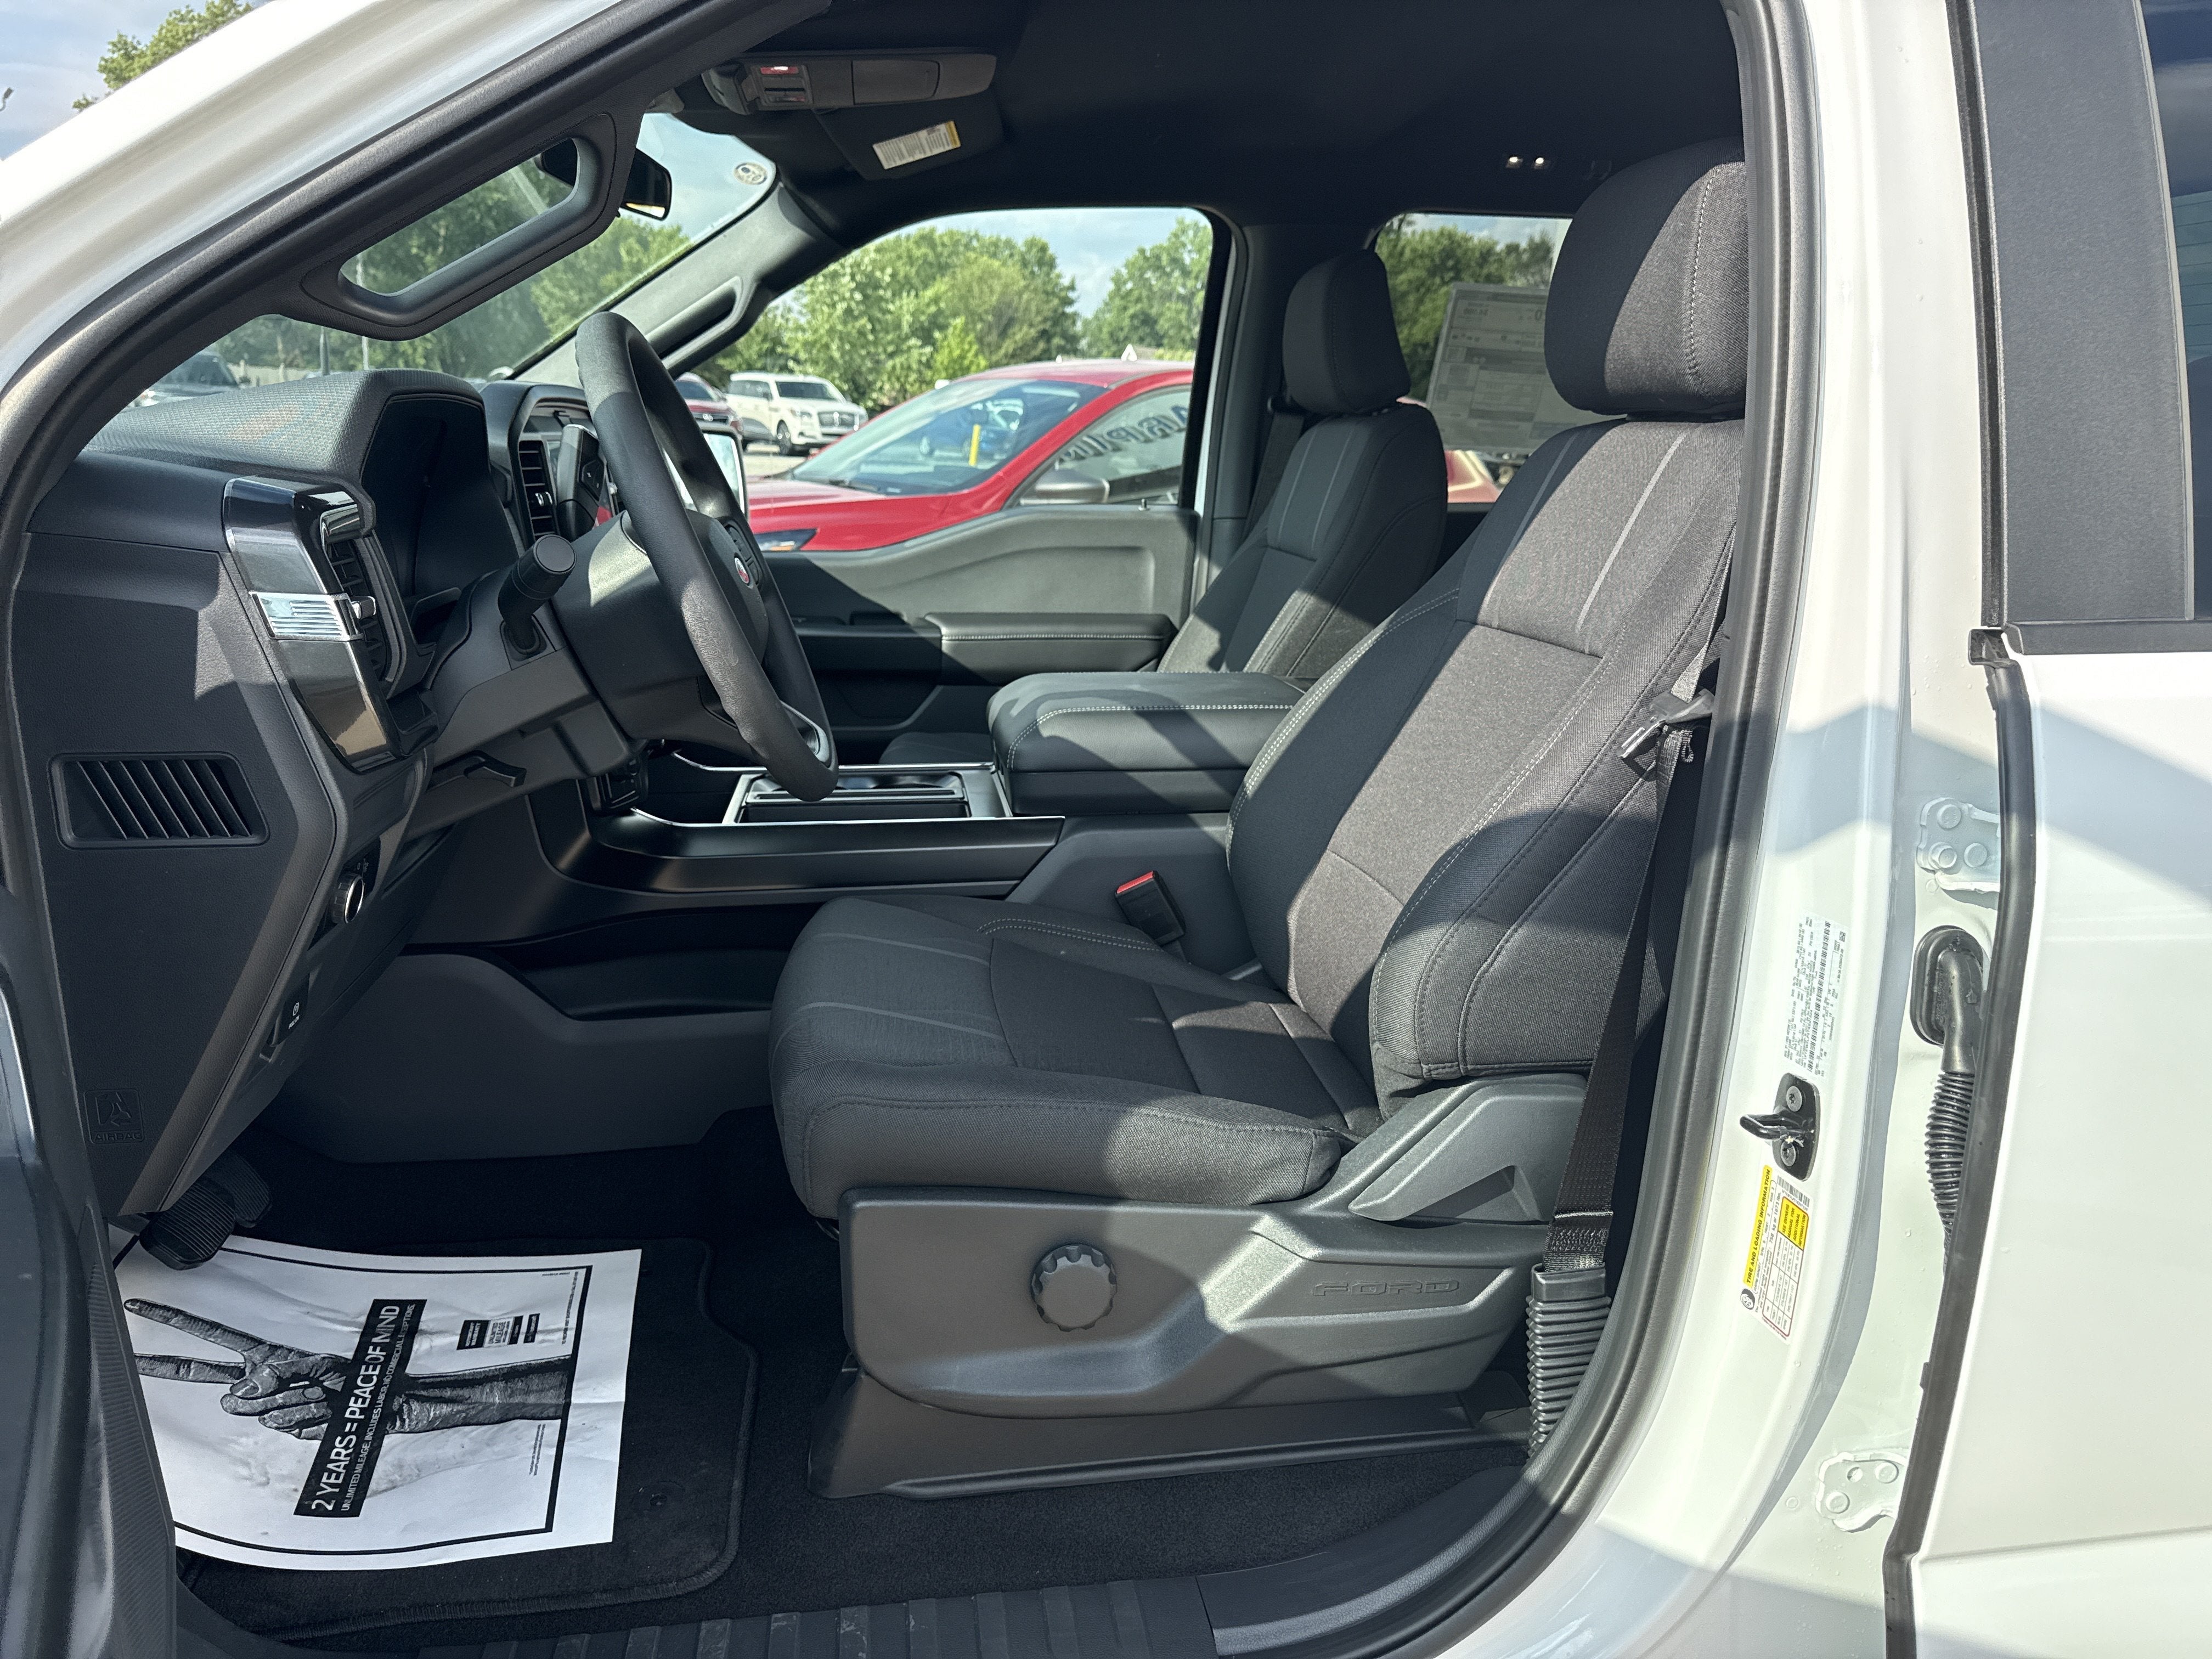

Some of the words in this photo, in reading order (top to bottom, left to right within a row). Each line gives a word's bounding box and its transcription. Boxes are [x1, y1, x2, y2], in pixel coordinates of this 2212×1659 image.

[94, 1131, 143, 1142] AIRBAG
[1753, 1218, 1762, 1251] LOADING
[1759, 1168, 1770, 1218] INFORMATION
[1792, 1212, 1801, 1241] ADDITIONAL
[1797, 1213, 1807, 1247] INFORMATION
[1313, 1280, 1460, 1296] FORD
[371, 1305, 400, 1342] MIND
[364, 1345, 386, 1362] OF
[344, 1364, 381, 1419] PEACE
[315, 1435, 357, 1496] YEARS
[340, 1474, 360, 1510] UNLIMITED
[353, 1441, 371, 1472] MILEAGE.
[364, 1408, 381, 1440] INCLUDES
[311, 1499, 335, 1510] 2
